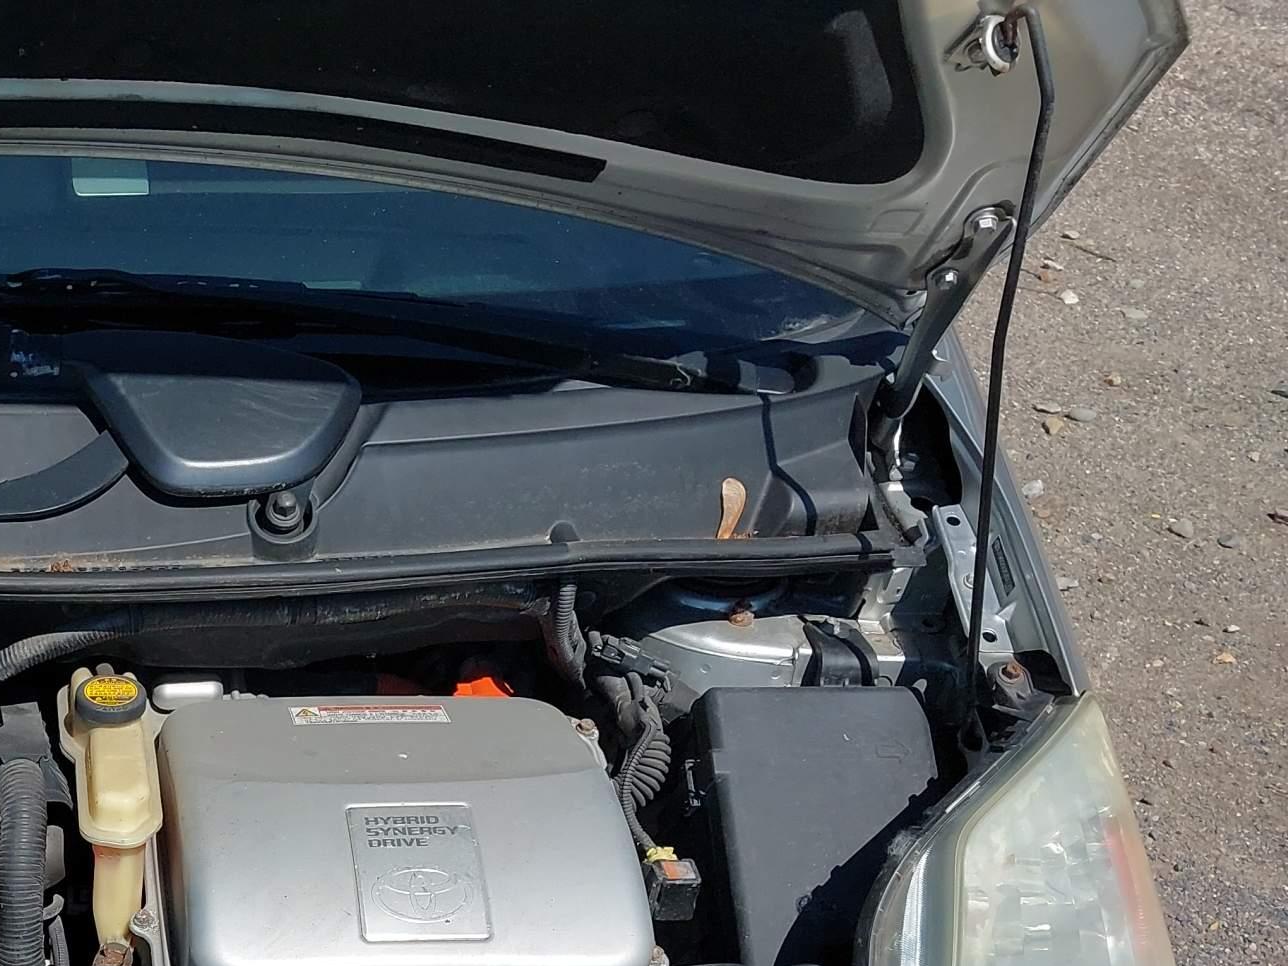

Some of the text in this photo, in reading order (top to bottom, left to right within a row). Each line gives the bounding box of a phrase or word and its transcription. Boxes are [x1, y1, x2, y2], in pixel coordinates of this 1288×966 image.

[364, 815, 440, 825] HYBRID
[365, 826, 459, 837] SYNERGY
[368, 837, 429, 848] DRIVE
